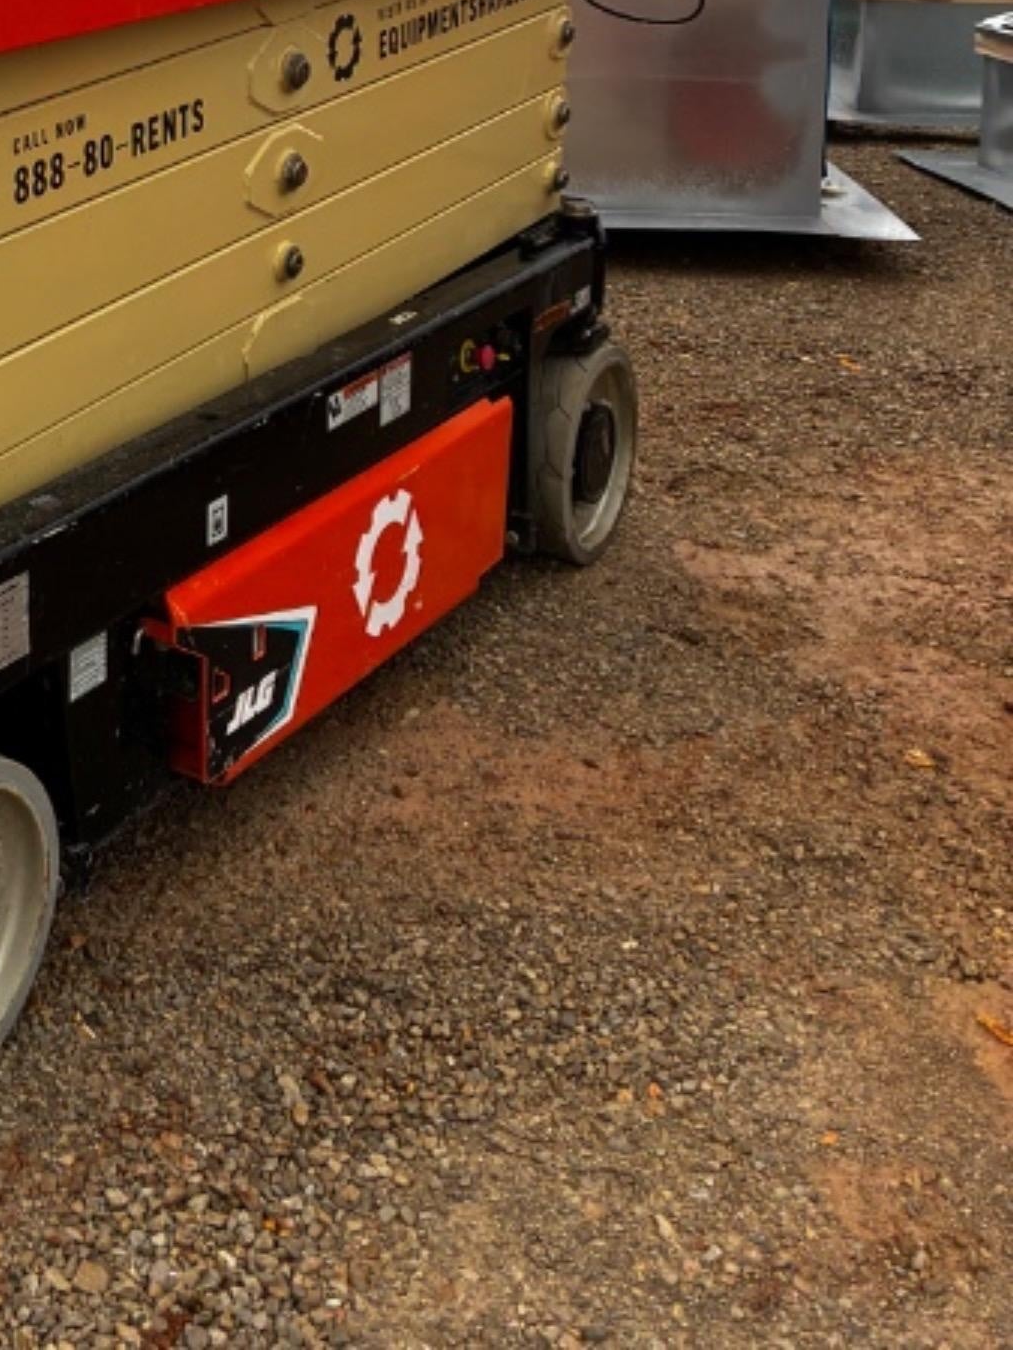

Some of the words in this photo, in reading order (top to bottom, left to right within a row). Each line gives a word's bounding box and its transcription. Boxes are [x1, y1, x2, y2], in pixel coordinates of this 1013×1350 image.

[13, 128, 49, 156] CALL
[55, 113, 87, 140] NOW
[14, 98, 205, 205] 888-80-RENTS
[226, 669, 277, 736] JLG
